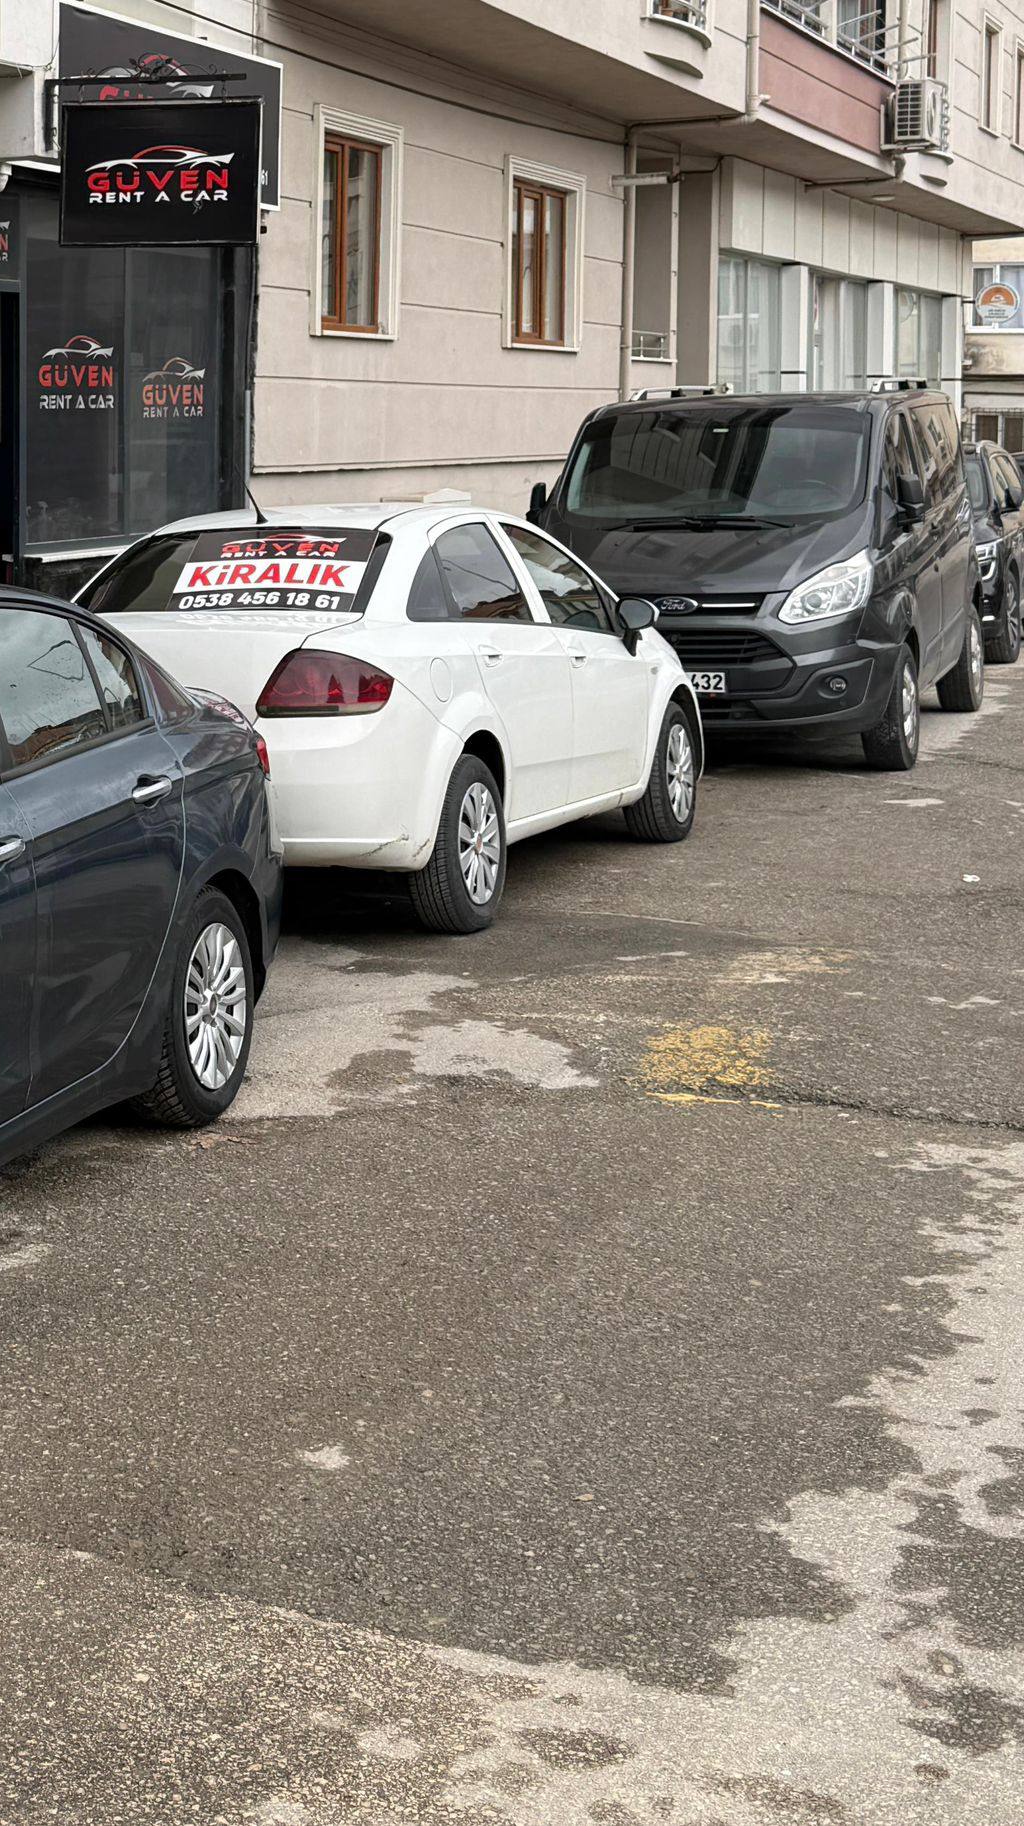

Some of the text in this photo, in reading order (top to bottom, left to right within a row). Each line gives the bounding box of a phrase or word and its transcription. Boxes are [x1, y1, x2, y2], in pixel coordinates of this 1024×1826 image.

[87, 168, 229, 192] GÜVEN
[89, 190, 228, 204] RENT A CAR
[38, 364, 113, 388] GÜVEN
[39, 394, 115, 410] RENT A CAR
[142, 384, 204, 406] GÜVEN
[143, 406, 204, 418] RENT A CAR
[178, 591, 340, 610] 0538 456 18 61
[660, 600, 686, 611] Ford
